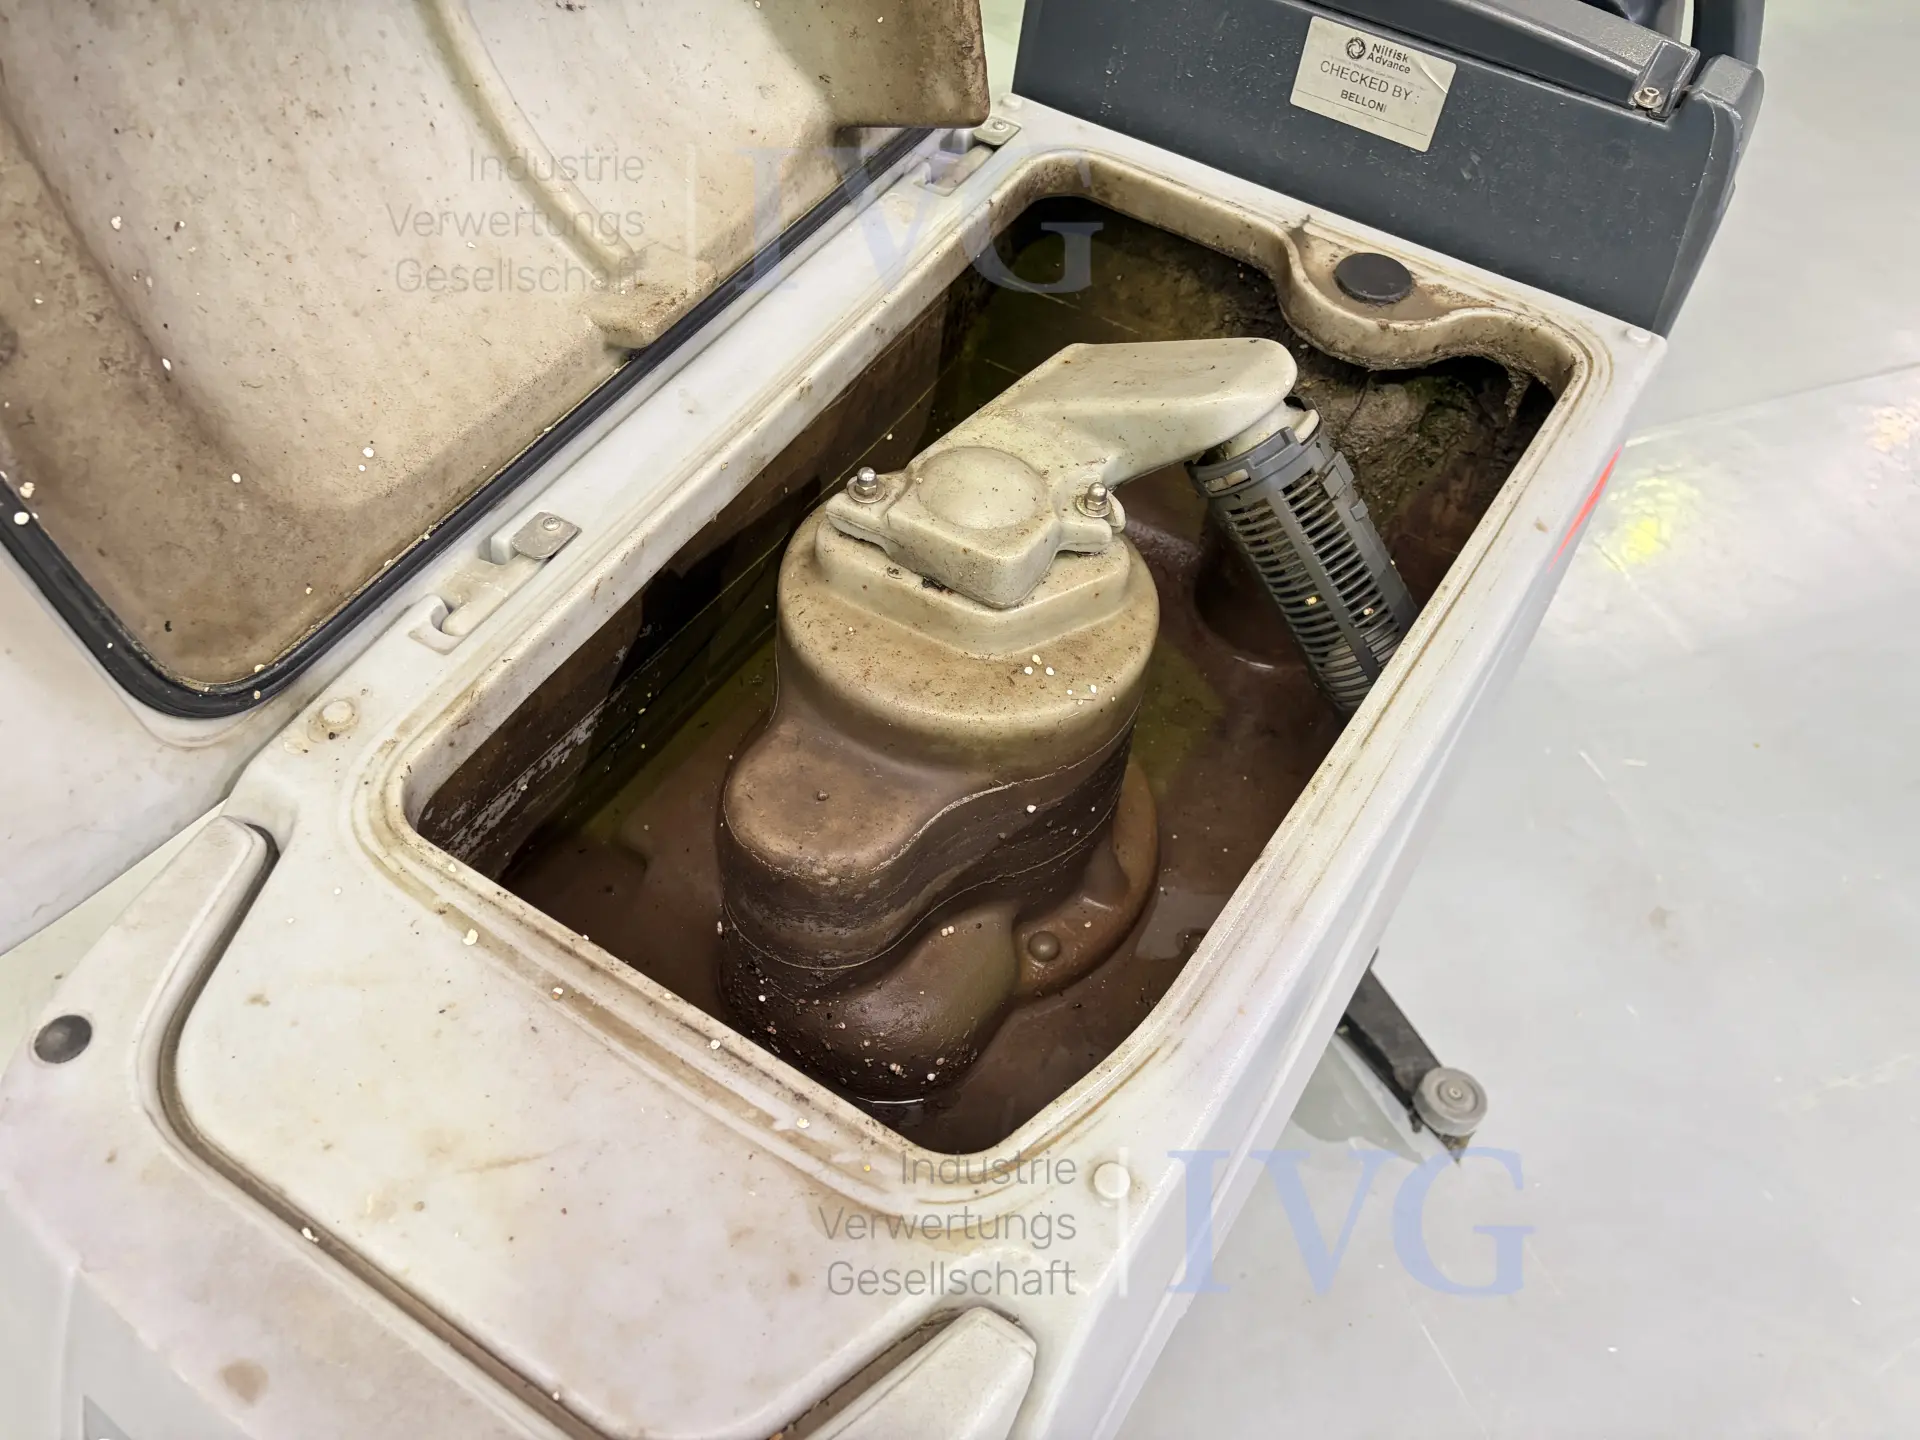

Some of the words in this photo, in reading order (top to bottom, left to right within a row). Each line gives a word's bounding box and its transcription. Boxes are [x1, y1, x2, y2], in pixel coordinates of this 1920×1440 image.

[1367, 52, 1411, 74] Advance
[1372, 43, 1409, 63] Nilfisk
[1320, 60, 1389, 93] CHECKED
[1340, 89, 1388, 113] BELLONI
